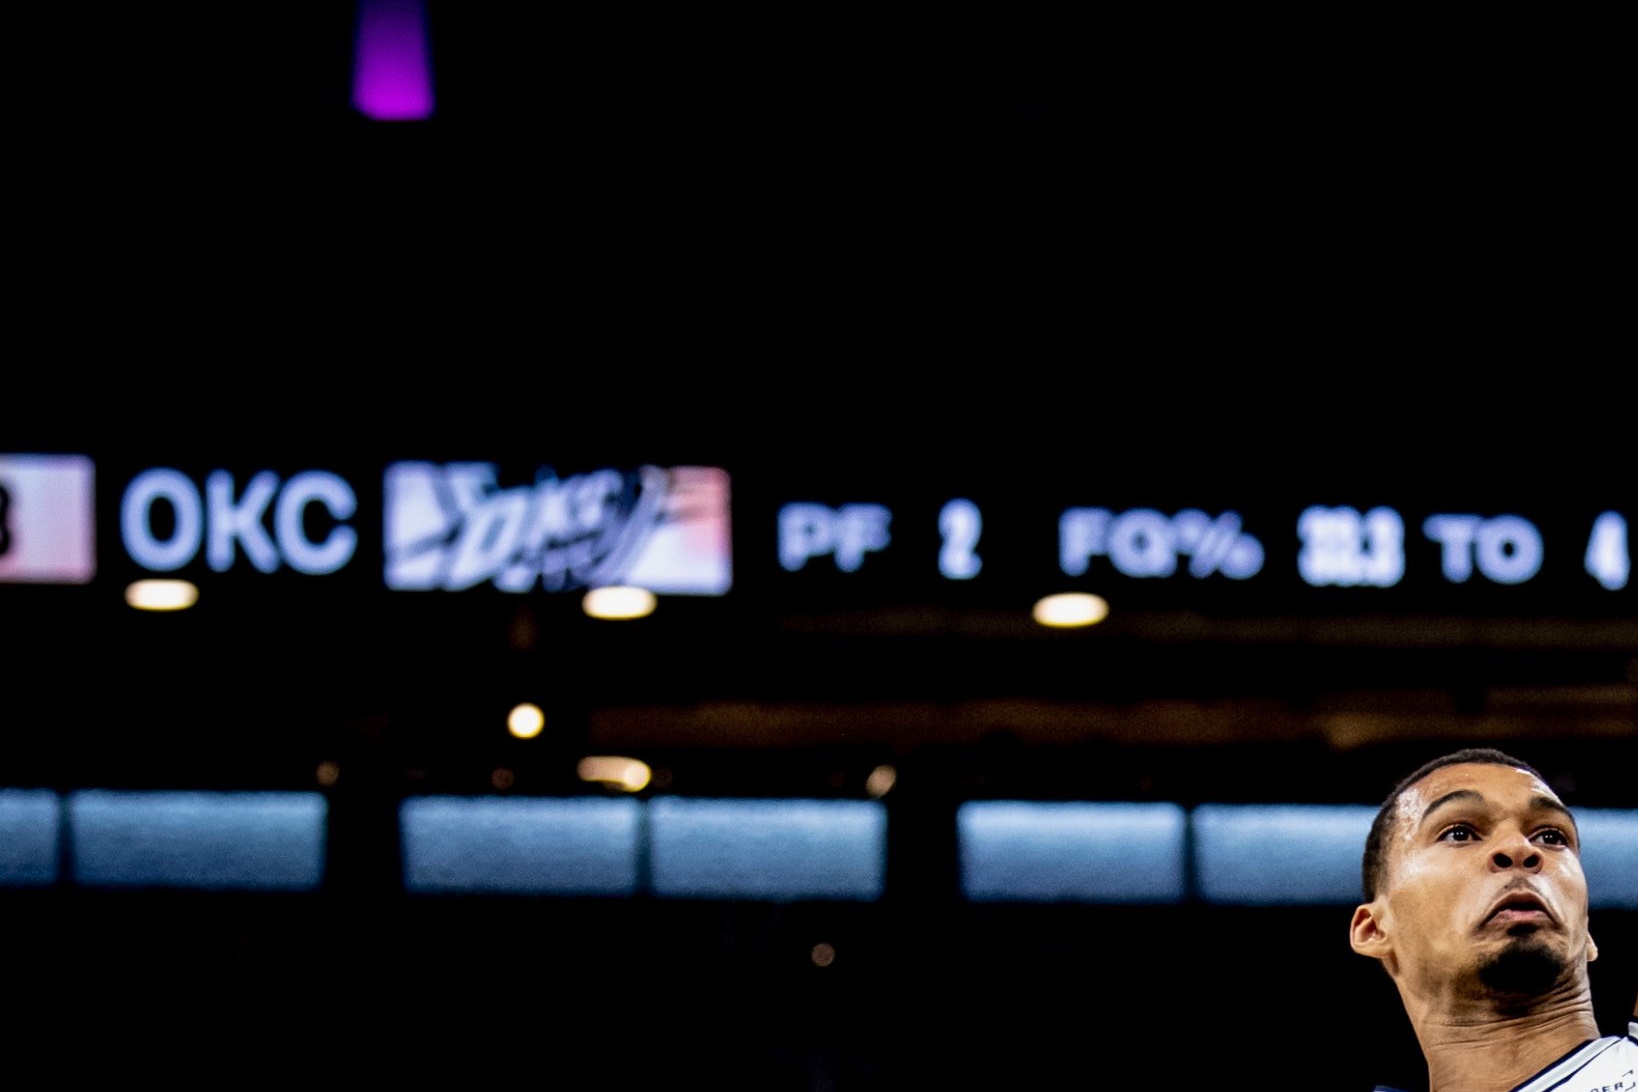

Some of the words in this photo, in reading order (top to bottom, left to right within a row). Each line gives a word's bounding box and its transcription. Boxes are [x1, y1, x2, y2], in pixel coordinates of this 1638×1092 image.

[120, 467, 358, 575] OKC
[779, 502, 892, 572] PF
[1422, 513, 1544, 585] TO
